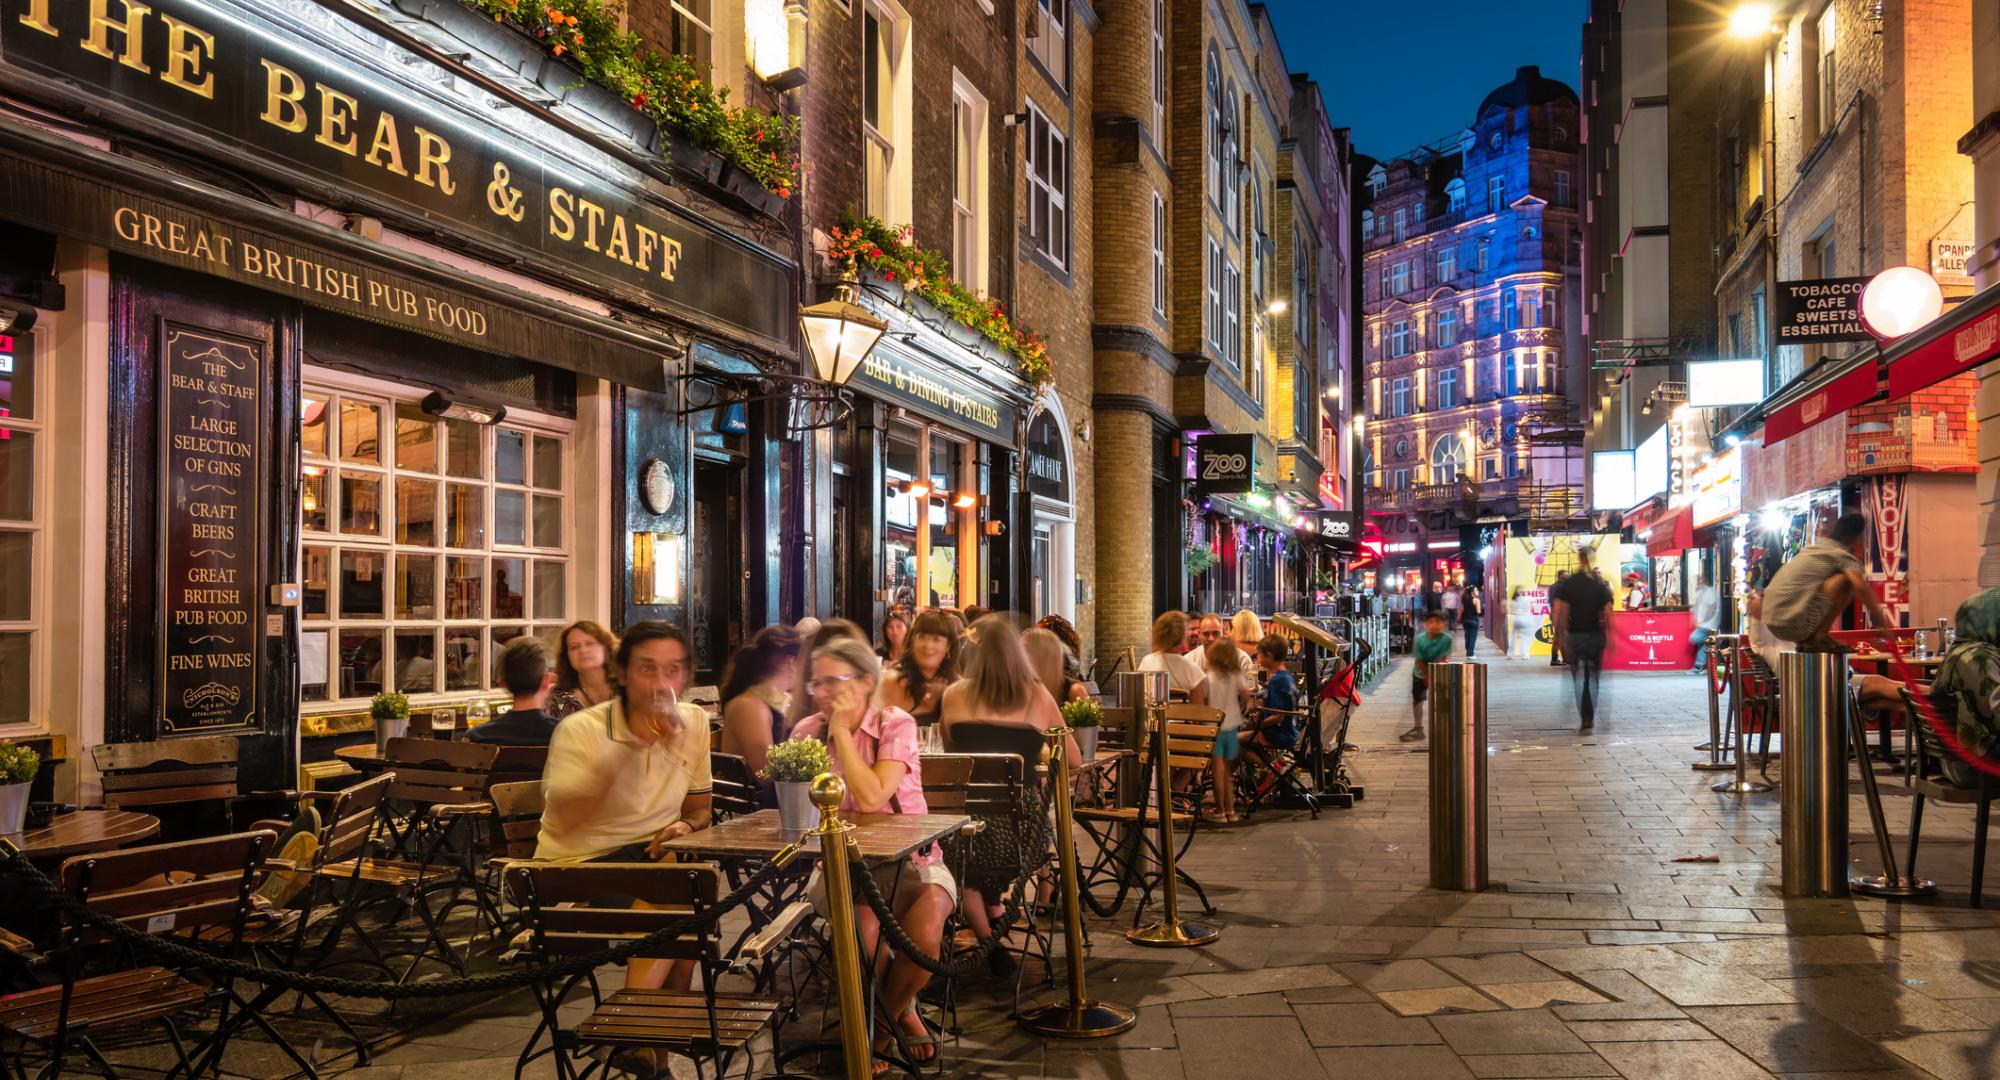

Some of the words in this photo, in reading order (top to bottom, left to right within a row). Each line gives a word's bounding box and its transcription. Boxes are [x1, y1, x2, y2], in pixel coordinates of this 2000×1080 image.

[260, 57, 456, 195] BEAR
[486, 161, 525, 222] &
[549, 187, 683, 282] STAFF
[114, 206, 233, 267] GREAT
[241, 244, 362, 303] BRITISH
[368, 280, 419, 317] PUB
[425, 295, 487, 337] FOOD
[1938, 258, 1967, 270] ALLEY
[1790, 283, 1862, 297] TOBACCO
[1806, 298, 1846, 309] CAFE
[1796, 310, 1857, 322] SWEETS
[1781, 323, 1865, 336] ESSENTIAL
[202, 361, 227, 377] THE
[172, 373, 205, 392] BEAR
[207, 381, 217, 394] &
[219, 382, 256, 400] STAFF
[864, 353, 891, 385] BAR
[895, 366, 905, 391] &
[908, 371, 950, 409] DINING
[953, 392, 998, 429] UPSTAIRS
[190, 415, 238, 436] LARGE
[174, 435, 251, 458] SELECTION
[185, 458, 205, 474] OF
[207, 460, 241, 477] GINS
[189, 503, 238, 520] CRAFT
[192, 524, 234, 540] BEERS
[1879, 481, 1901, 629] SOUVEN
[188, 569, 236, 583] GREAT
[183, 589, 240, 604] BRITISH
[175, 611, 204, 625] PUB
[207, 610, 247, 625] FOOD
[170, 655, 204, 670] FINE
[206, 652, 251, 669] WINES
